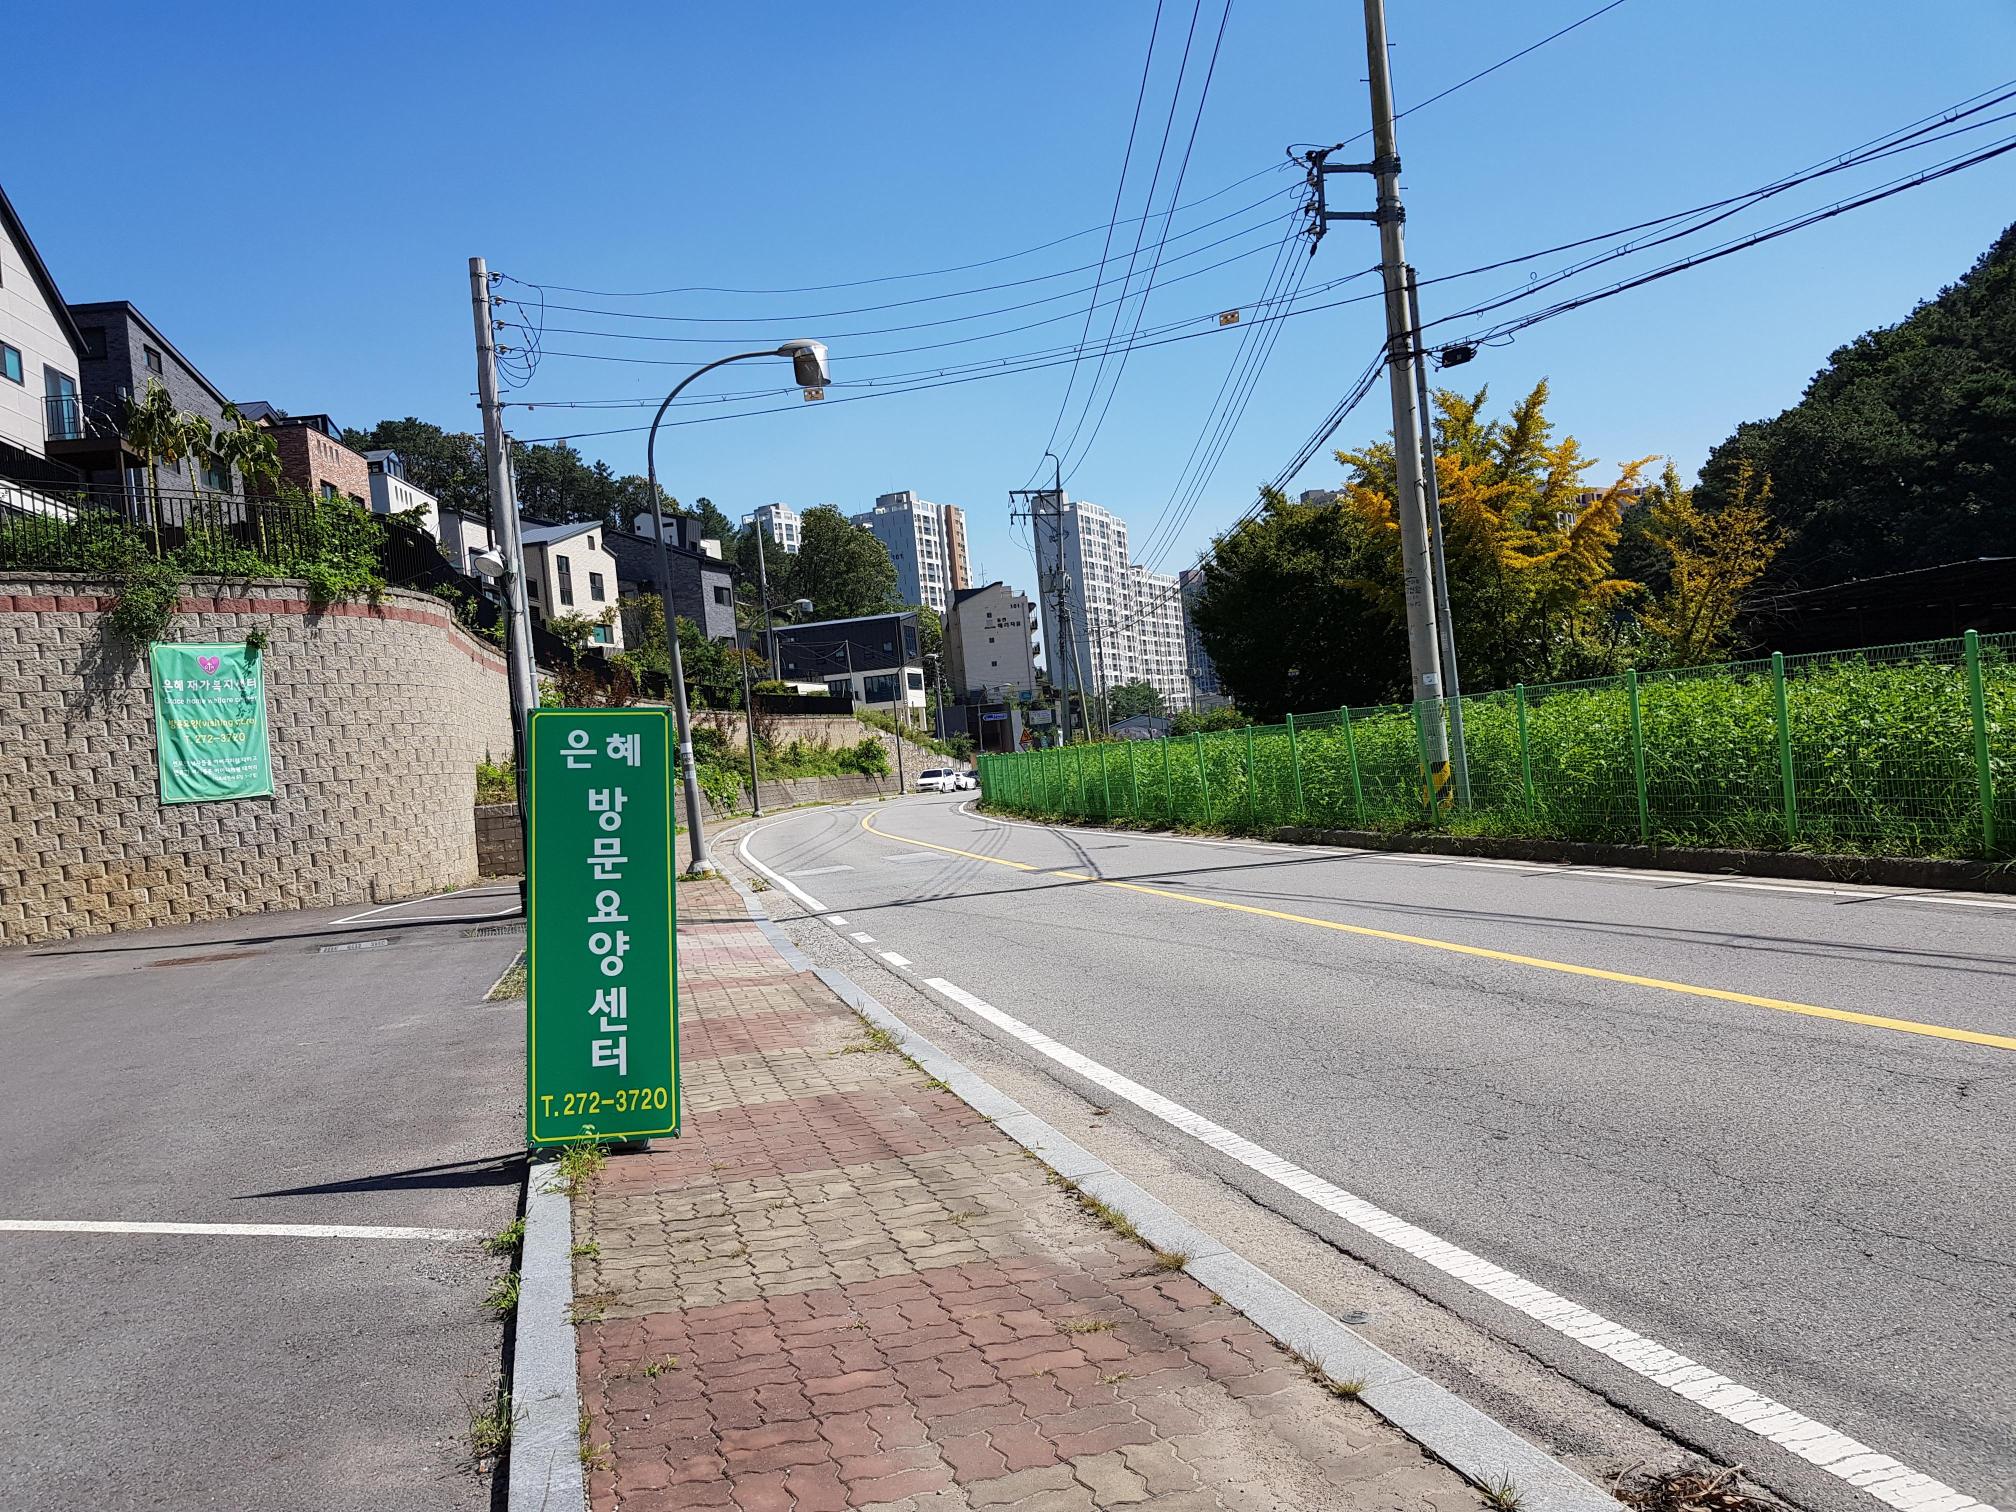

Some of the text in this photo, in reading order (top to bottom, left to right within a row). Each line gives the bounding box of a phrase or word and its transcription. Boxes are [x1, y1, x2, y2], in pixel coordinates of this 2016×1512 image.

[162, 679, 184, 693] 은혜
[195, 732, 246, 744] 272-3720
[560, 728, 642, 770] 은혜
[587, 786, 631, 1076] 방문요양센터
[540, 1087, 668, 1119] T.272-3720
